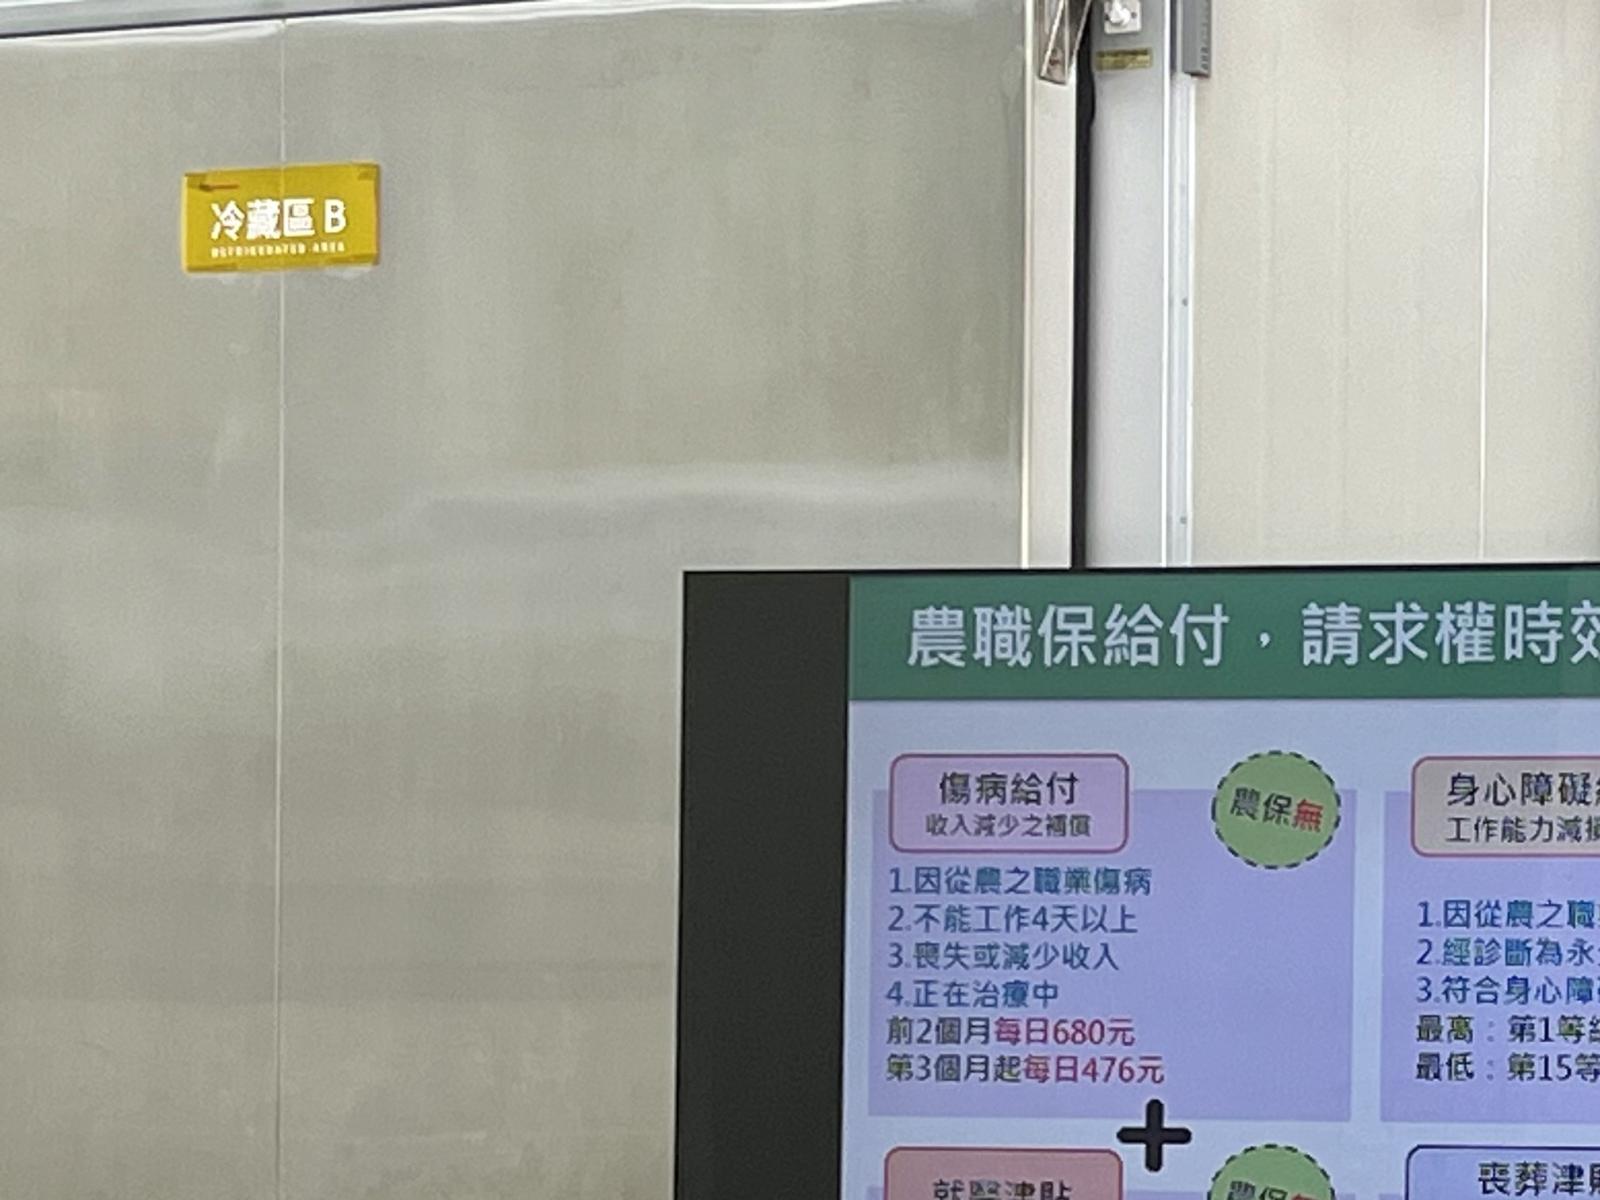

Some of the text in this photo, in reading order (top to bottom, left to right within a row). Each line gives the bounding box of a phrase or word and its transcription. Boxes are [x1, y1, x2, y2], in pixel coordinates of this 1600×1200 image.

[210, 198, 347, 241] 冷藏區 B
[939, 771, 1079, 806] 傷病給付
[1228, 787, 1325, 833] 農保無
[924, 813, 1092, 838] 收入減少之補償
[889, 866, 1152, 897] 1.因從農之職業傷病
[888, 904, 1138, 934] 2.不能工作4天以上
[888, 942, 1119, 971] 3.喪失或減少收入
[886, 980, 1059, 1009] 4.正在治療中
[886, 1016, 1136, 1046] 前2個月每日680元
[886, 1054, 1165, 1084] 第3個月起每日476元
